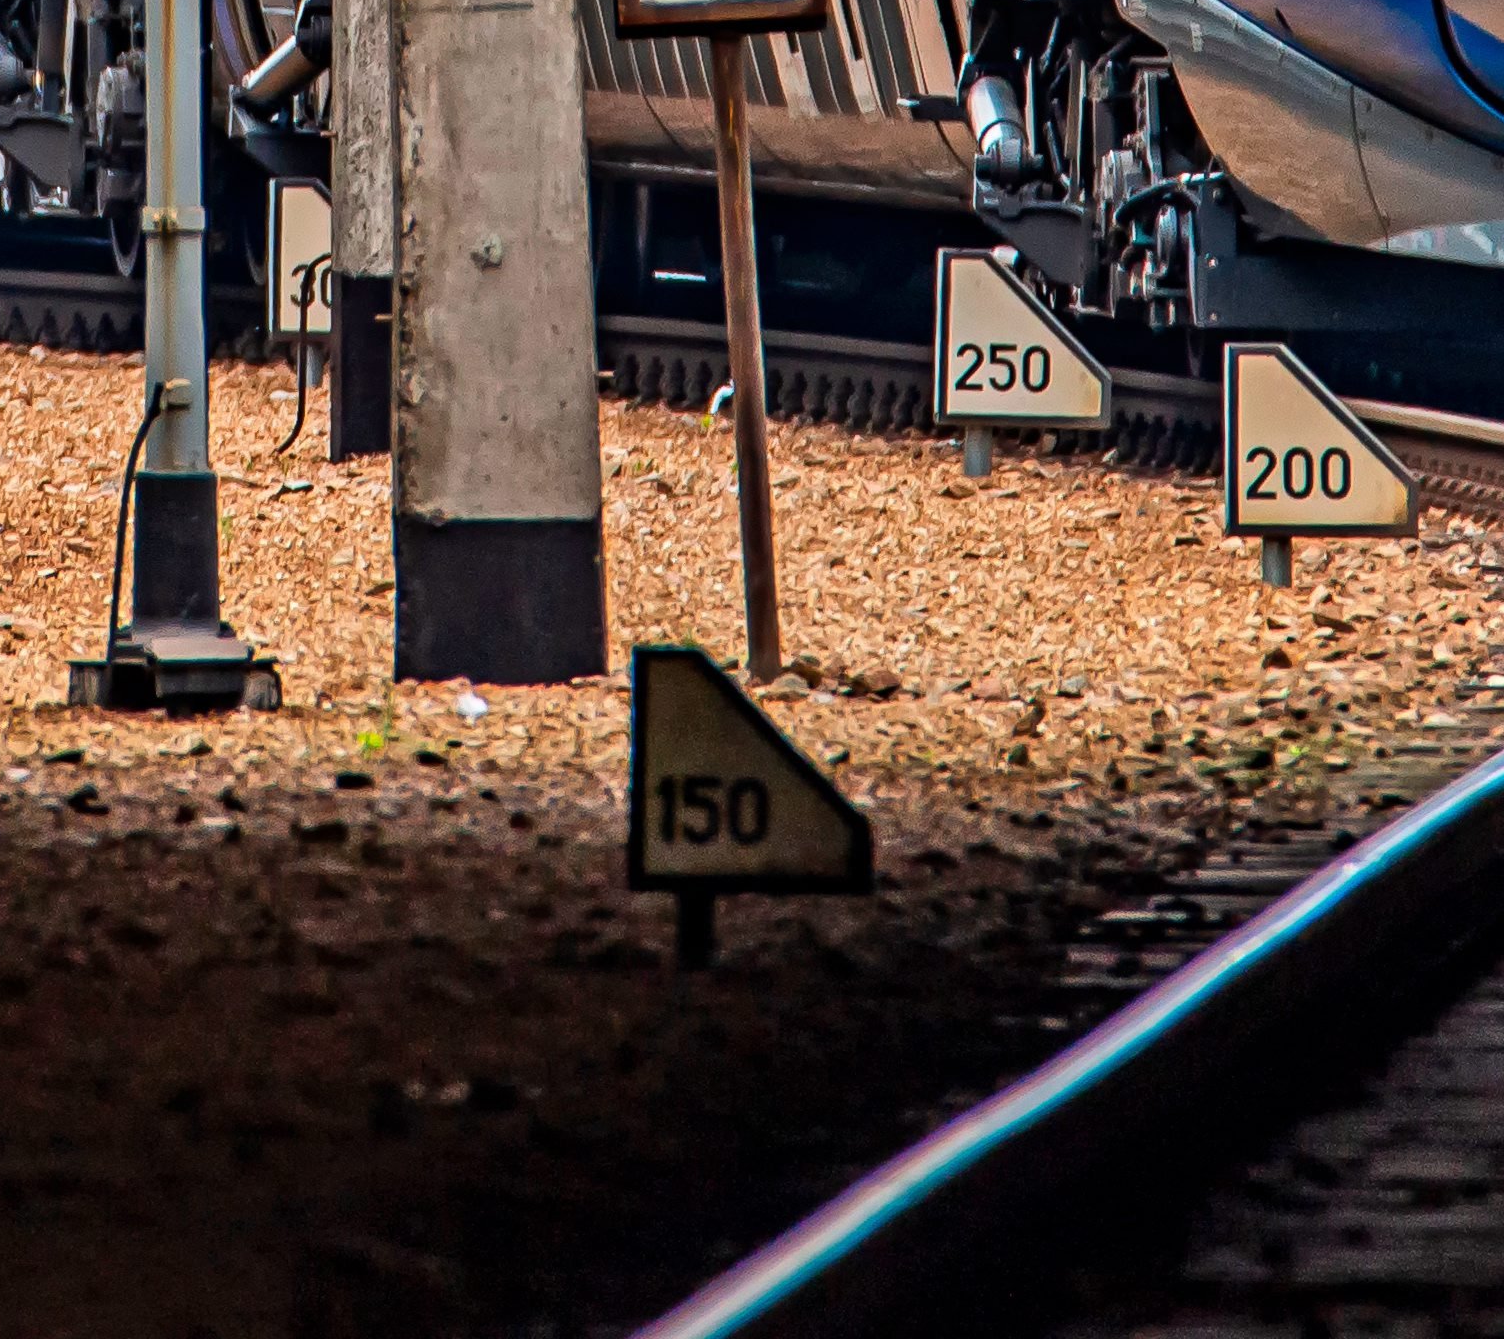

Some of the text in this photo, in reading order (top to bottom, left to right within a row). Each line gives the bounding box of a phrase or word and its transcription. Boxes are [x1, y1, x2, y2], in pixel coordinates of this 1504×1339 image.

[954, 342, 1052, 394] 250
[1245, 445, 1352, 501] 200
[656, 776, 770, 845] 150
